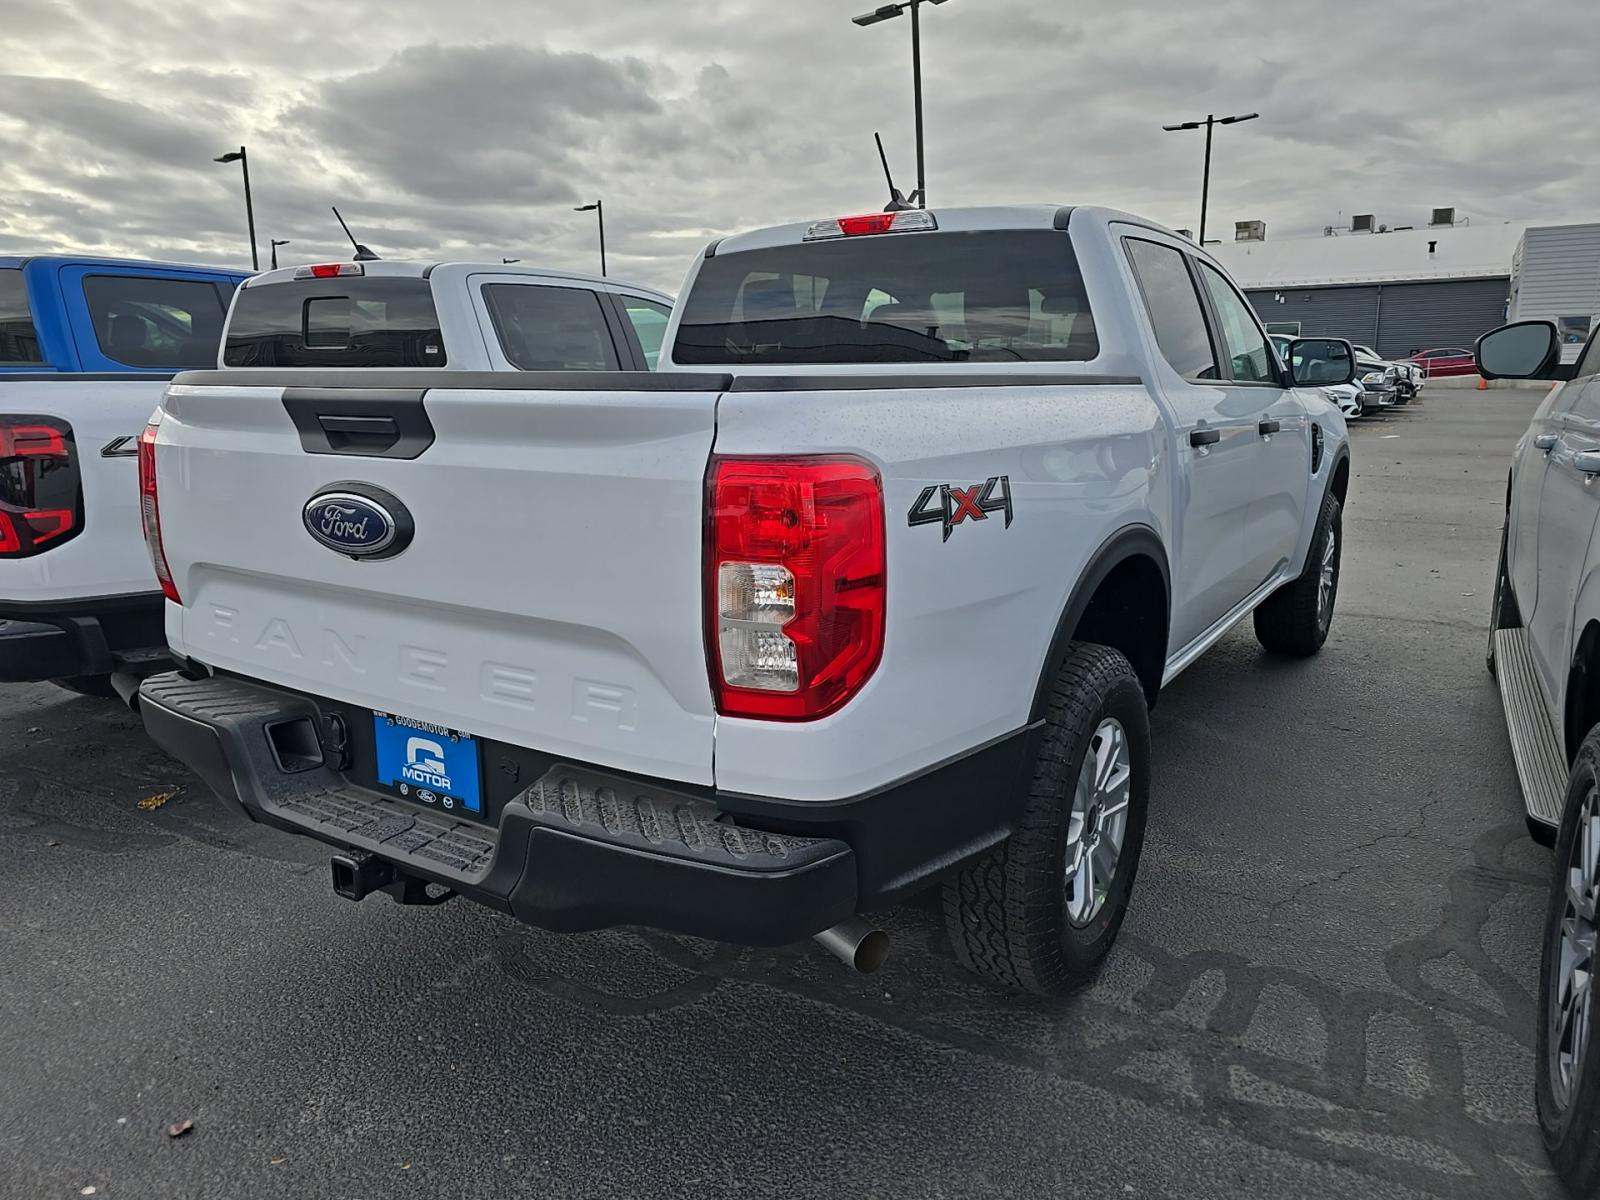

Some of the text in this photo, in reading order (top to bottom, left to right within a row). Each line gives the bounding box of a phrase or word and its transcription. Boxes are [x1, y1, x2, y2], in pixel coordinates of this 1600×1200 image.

[321, 504, 368, 540] Ford
[207, 602, 640, 732] RANGER
[395, 715, 450, 737] GOODEMOTOR
[402, 766, 452, 790] MOTOR
